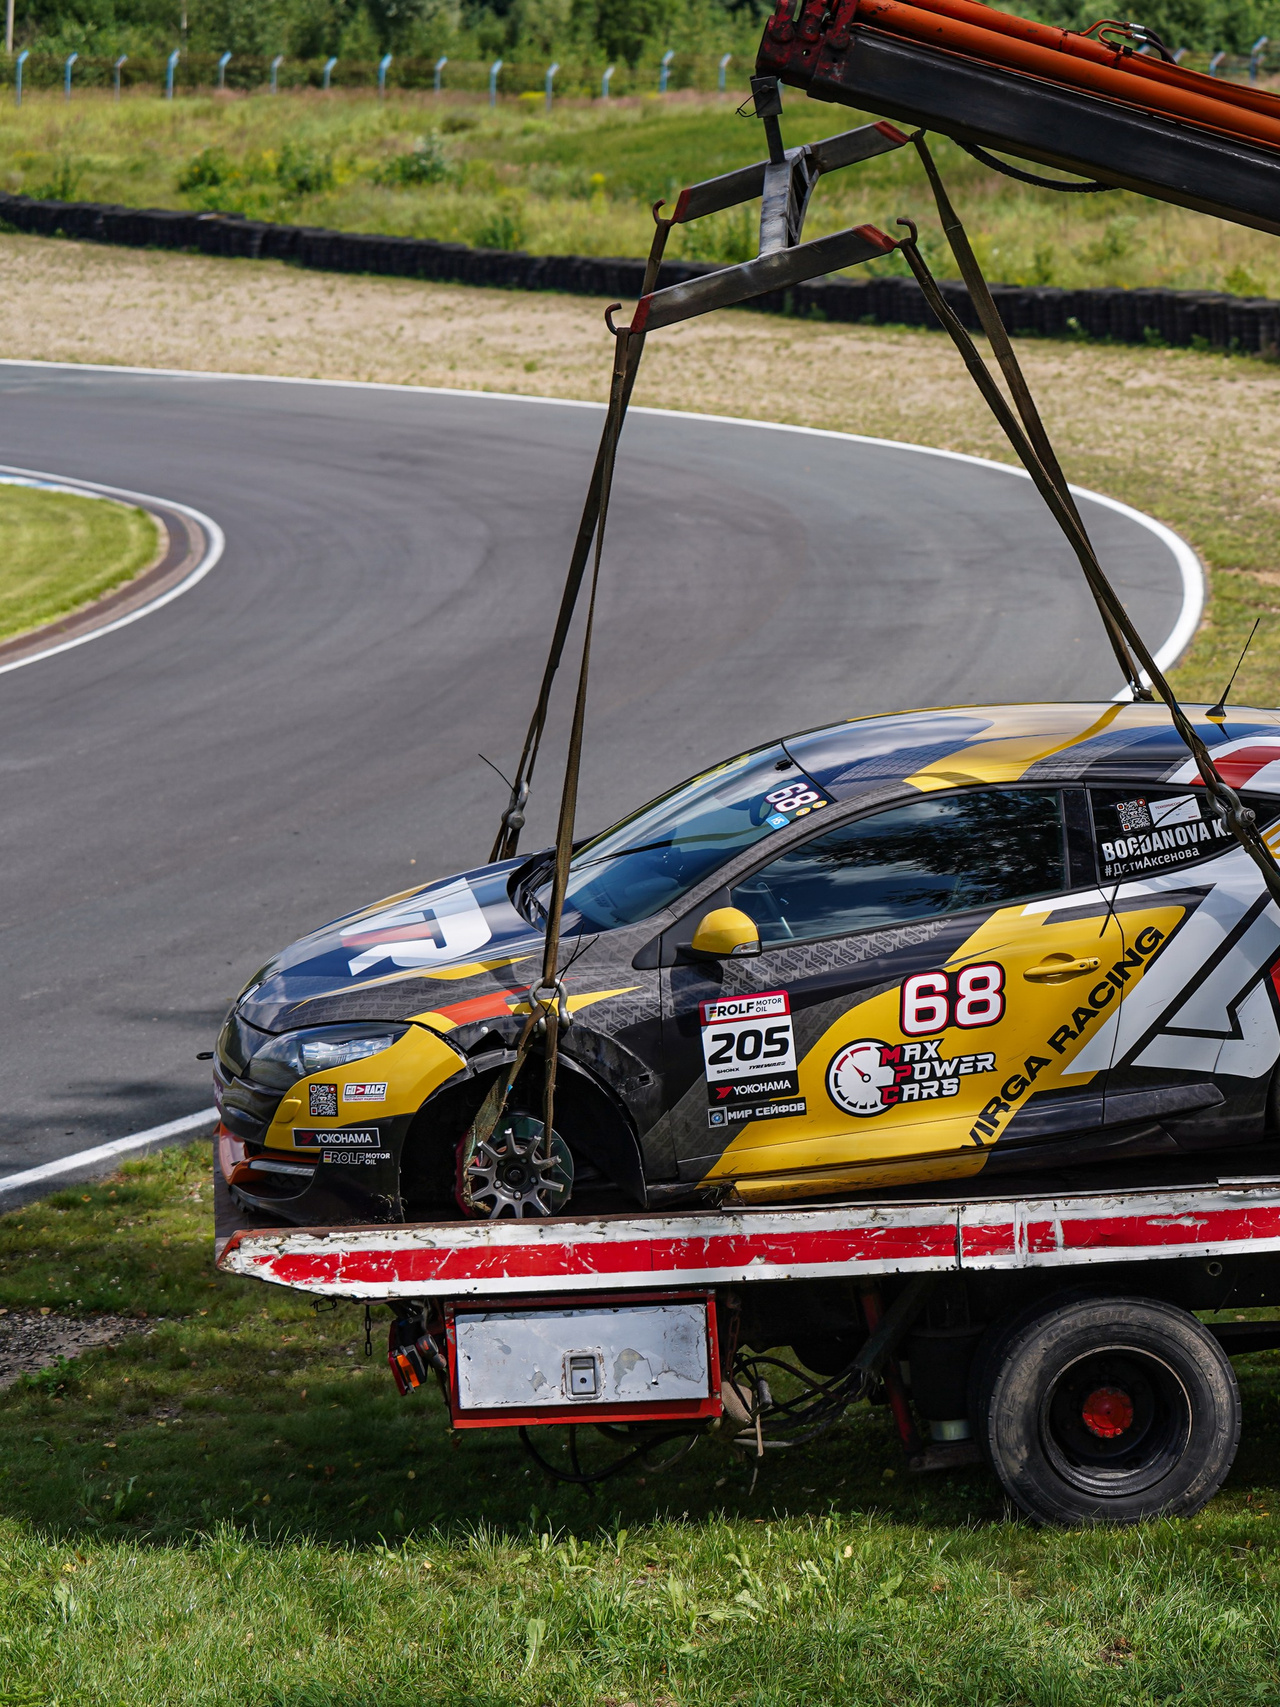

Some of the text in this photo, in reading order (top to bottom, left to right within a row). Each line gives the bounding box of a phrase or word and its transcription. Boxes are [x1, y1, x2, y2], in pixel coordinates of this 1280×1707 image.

[765, 782, 821, 813] 68
[1101, 821, 1212, 862] BOGDANOVA
[717, 997, 783, 1017] ROLF MOTOR
[902, 963, 1003, 1036] 68
[708, 1025, 790, 1066] 205
[960, 926, 1165, 1149] VIRGA RACING
[880, 1040, 941, 1065] MAX
[893, 1053, 996, 1083] POWER
[733, 1079, 792, 1096] YOKOHAMA
[880, 1077, 960, 1104] CARS
[727, 1101, 806, 1121] МИР СЕЙФОВ
[315, 1133, 373, 1144] YOKOHAMA
[330, 1151, 391, 1165] ROLF MOTOR
